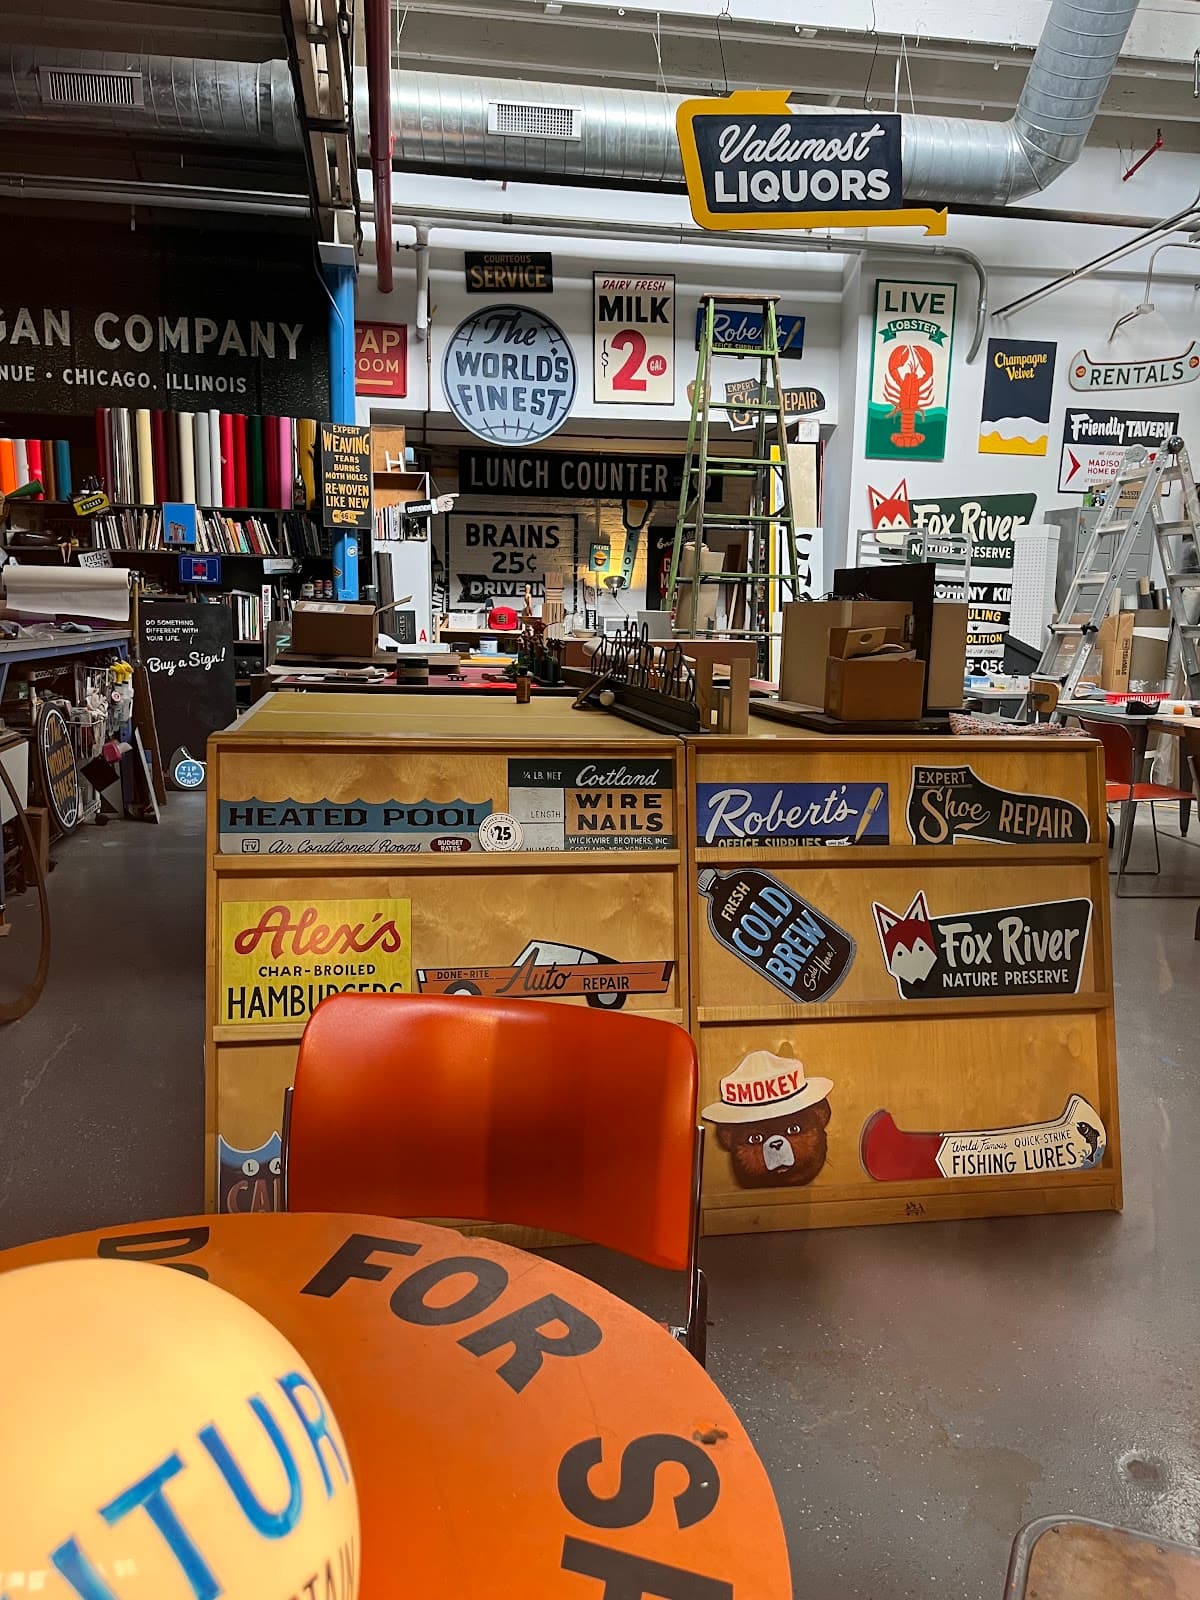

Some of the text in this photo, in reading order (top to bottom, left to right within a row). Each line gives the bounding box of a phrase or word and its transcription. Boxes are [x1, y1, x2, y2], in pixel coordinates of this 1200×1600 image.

[718, 122, 885, 164] Valumost
[714, 168, 891, 202] LIQUORS
[484, 255, 532, 264] COURTEOUS
[470, 265, 547, 289] SERVICE
[602, 279, 666, 291] DAIRY FRESH
[599, 295, 671, 324] MILK
[884, 290, 946, 314] LIVE
[0, 307, 304, 360] AN COMPANY
[484, 310, 538, 347] The
[889, 318, 938, 335] LOBSTER
[358, 358, 399, 373] OOM
[456, 347, 569, 383] WORLD'S
[994, 351, 1048, 370] Champagne
[62, 367, 157, 391] CHICAGO,
[166, 372, 247, 394] ILLINOIS
[1007, 365, 1035, 382] Velvet
[1089, 361, 1185, 387] RENTALS
[727, 380, 755, 393] EXPERT
[457, 384, 567, 421] FINEST
[784, 391, 818, 411] EPAIR
[332, 425, 361, 434] EXPERT
[1070, 413, 1174, 445] Friendly TAVERN
[322, 429, 370, 456] WEAVING
[333, 464, 361, 473] BURNS
[334, 455, 360, 464] TEARS
[1088, 459, 1120, 467] MADISO
[325, 472, 369, 482] MOTH HOLES
[470, 456, 549, 490] LUNCH
[560, 460, 668, 493] COUNTER
[325, 483, 369, 497] RE-WOVEN
[325, 495, 370, 509] LIKE NEW
[912, 501, 1026, 543] Fox River
[466, 523, 560, 549] BRAINS
[492, 551, 538, 574] 25¢
[934, 584, 988, 601] OHNNY
[146, 646, 226, 676] Buy a Sign!
[546, 771, 562, 781] NET
[575, 764, 660, 787] Cortland
[918, 771, 967, 785] EXPERT
[575, 793, 662, 809] WIRE
[228, 807, 482, 827] HEATED POOL
[531, 810, 561, 819] LENGTH
[577, 812, 663, 832] NAILS
[705, 785, 858, 843] Robert's
[918, 786, 1073, 844] Shoe REPAIR
[268, 838, 421, 854] Air Conditioned Rooms
[568, 836, 610, 844] WICKWIRE
[718, 838, 759, 848] OFFICE
[765, 838, 821, 848] SUPPLIES
[721, 881, 750, 921] FRESH
[234, 905, 401, 960] Alex's
[732, 886, 793, 958] COLD
[765, 909, 826, 987] BREW
[938, 916, 1080, 968] Fox River
[258, 964, 376, 978] CHAR-BROILED
[436, 969, 490, 980] DONE-RITE
[494, 947, 630, 994] Auto REPAIR
[803, 963, 819, 992] Sold
[942, 968, 1070, 988] NATURE PRESERVE
[725, 1070, 800, 1103] SMOKEY
[951, 1129, 1072, 1153] World Famous QUICK-STRIKE
[952, 1142, 1077, 1175] FISHING LURES
[300, 1232, 603, 1394] FOR
